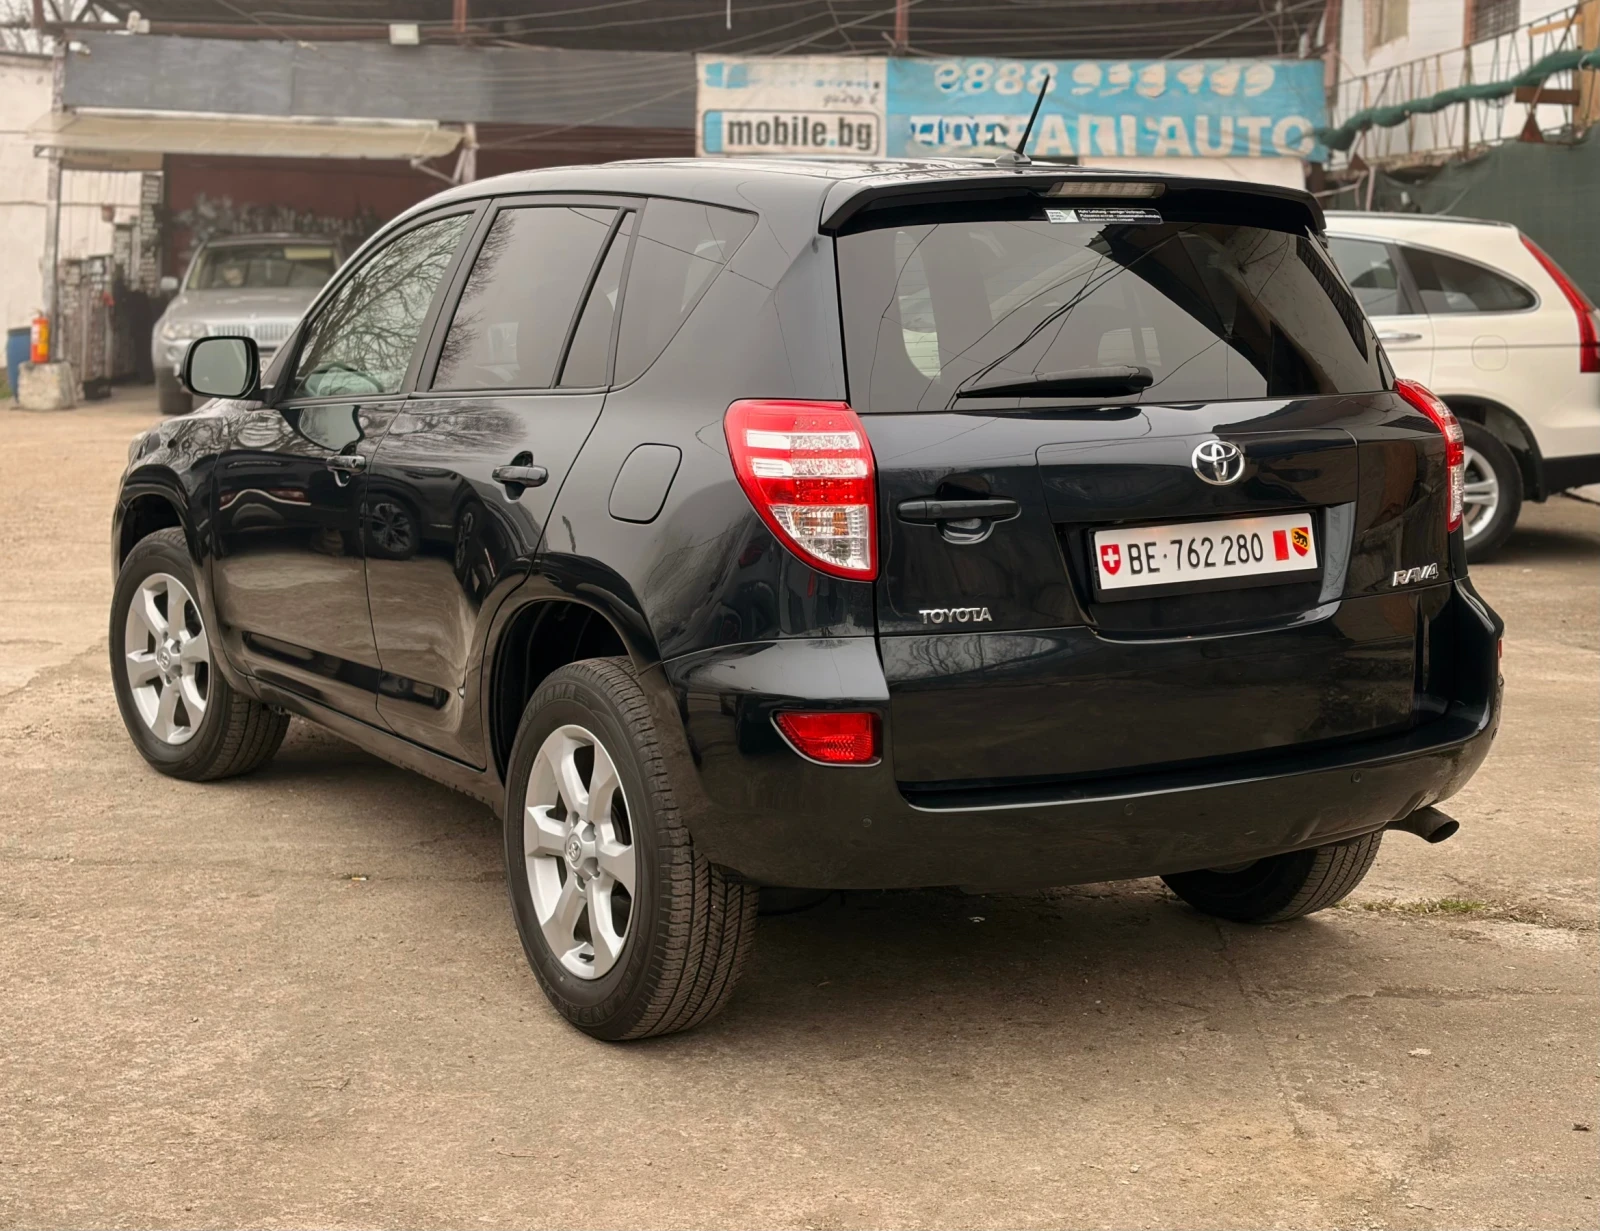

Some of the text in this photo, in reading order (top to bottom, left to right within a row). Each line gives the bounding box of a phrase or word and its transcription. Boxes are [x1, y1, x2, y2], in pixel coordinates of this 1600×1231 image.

[727, 115, 872, 151] mobile.bg
[1152, 115, 1316, 157] AUTO
[918, 607, 993, 624] TOYOTA
